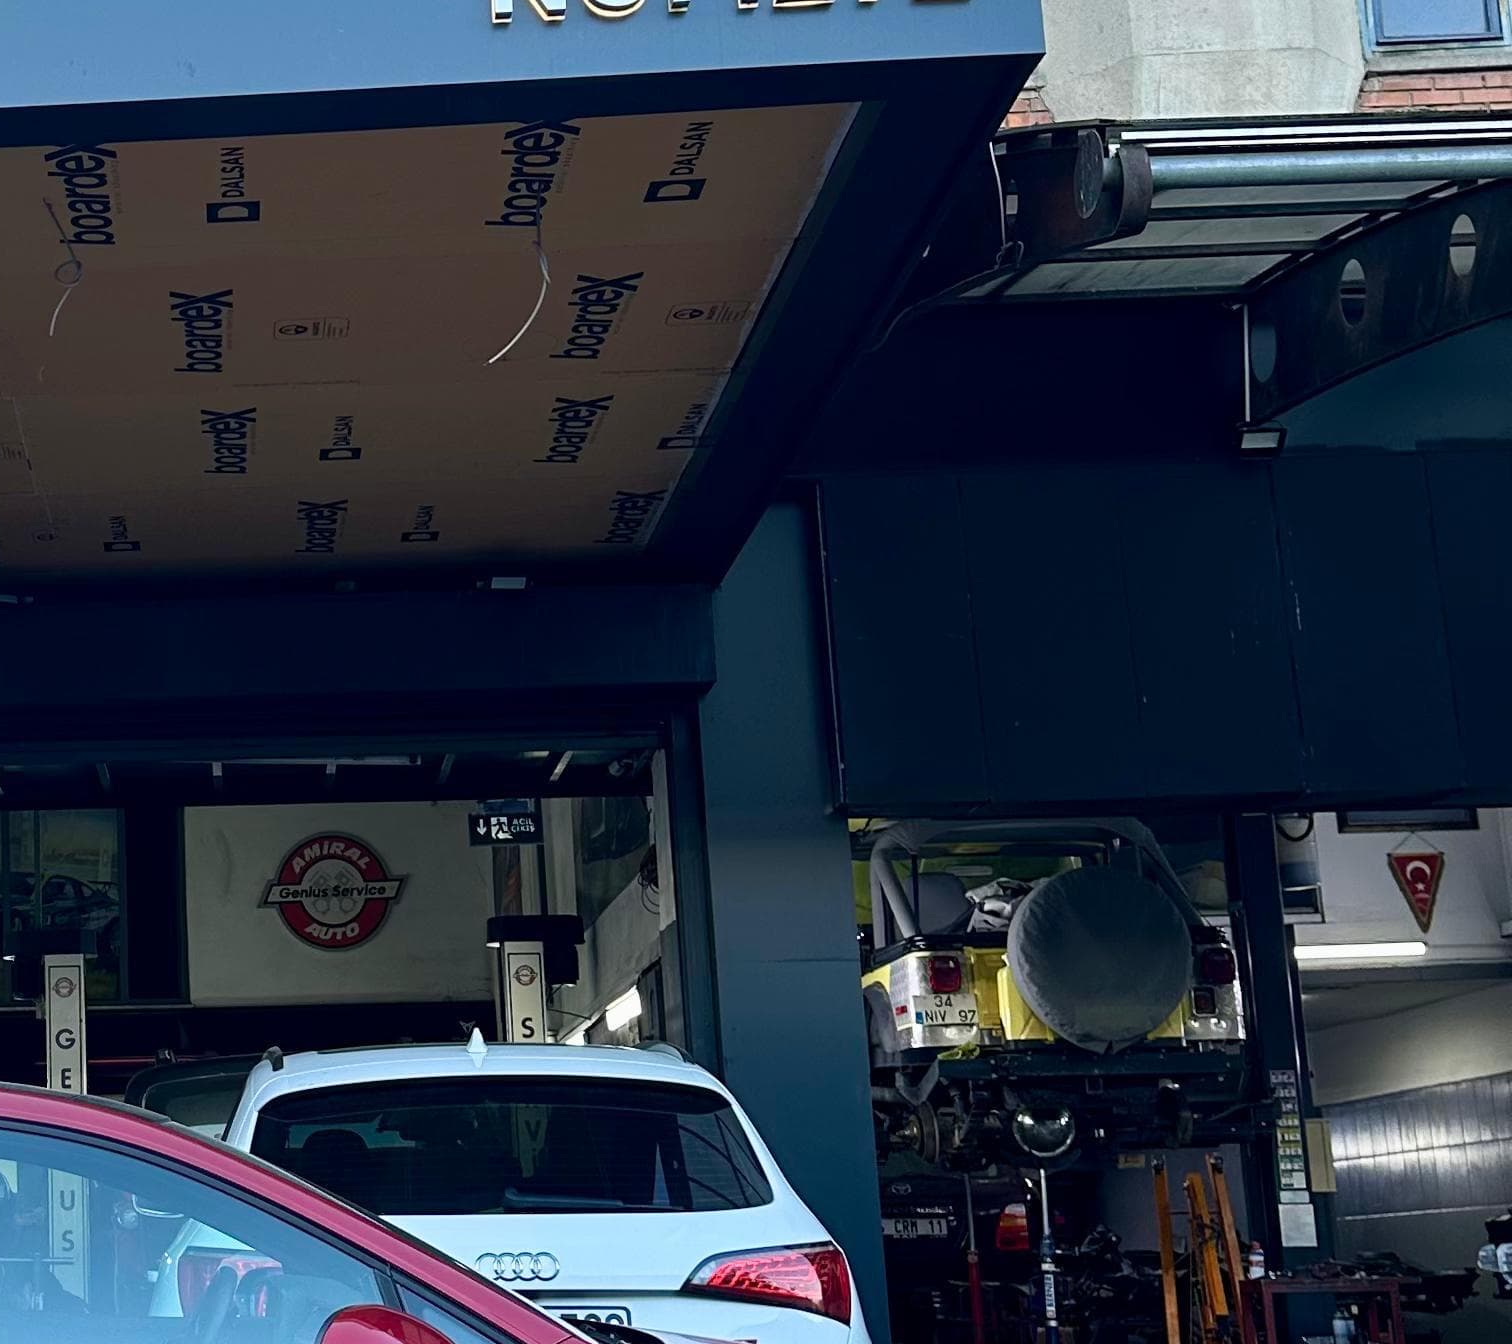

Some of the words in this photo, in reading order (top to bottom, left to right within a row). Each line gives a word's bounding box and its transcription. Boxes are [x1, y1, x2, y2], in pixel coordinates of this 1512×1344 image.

[669, 121, 713, 176] DALSAN
[221, 146, 246, 199] DALSAN
[279, 885, 329, 899] Genius
[333, 883, 386, 897] Service
[304, 921, 360, 941] AUTO
[934, 996, 953, 1008] 34
[959, 1011, 976, 1022] 97
